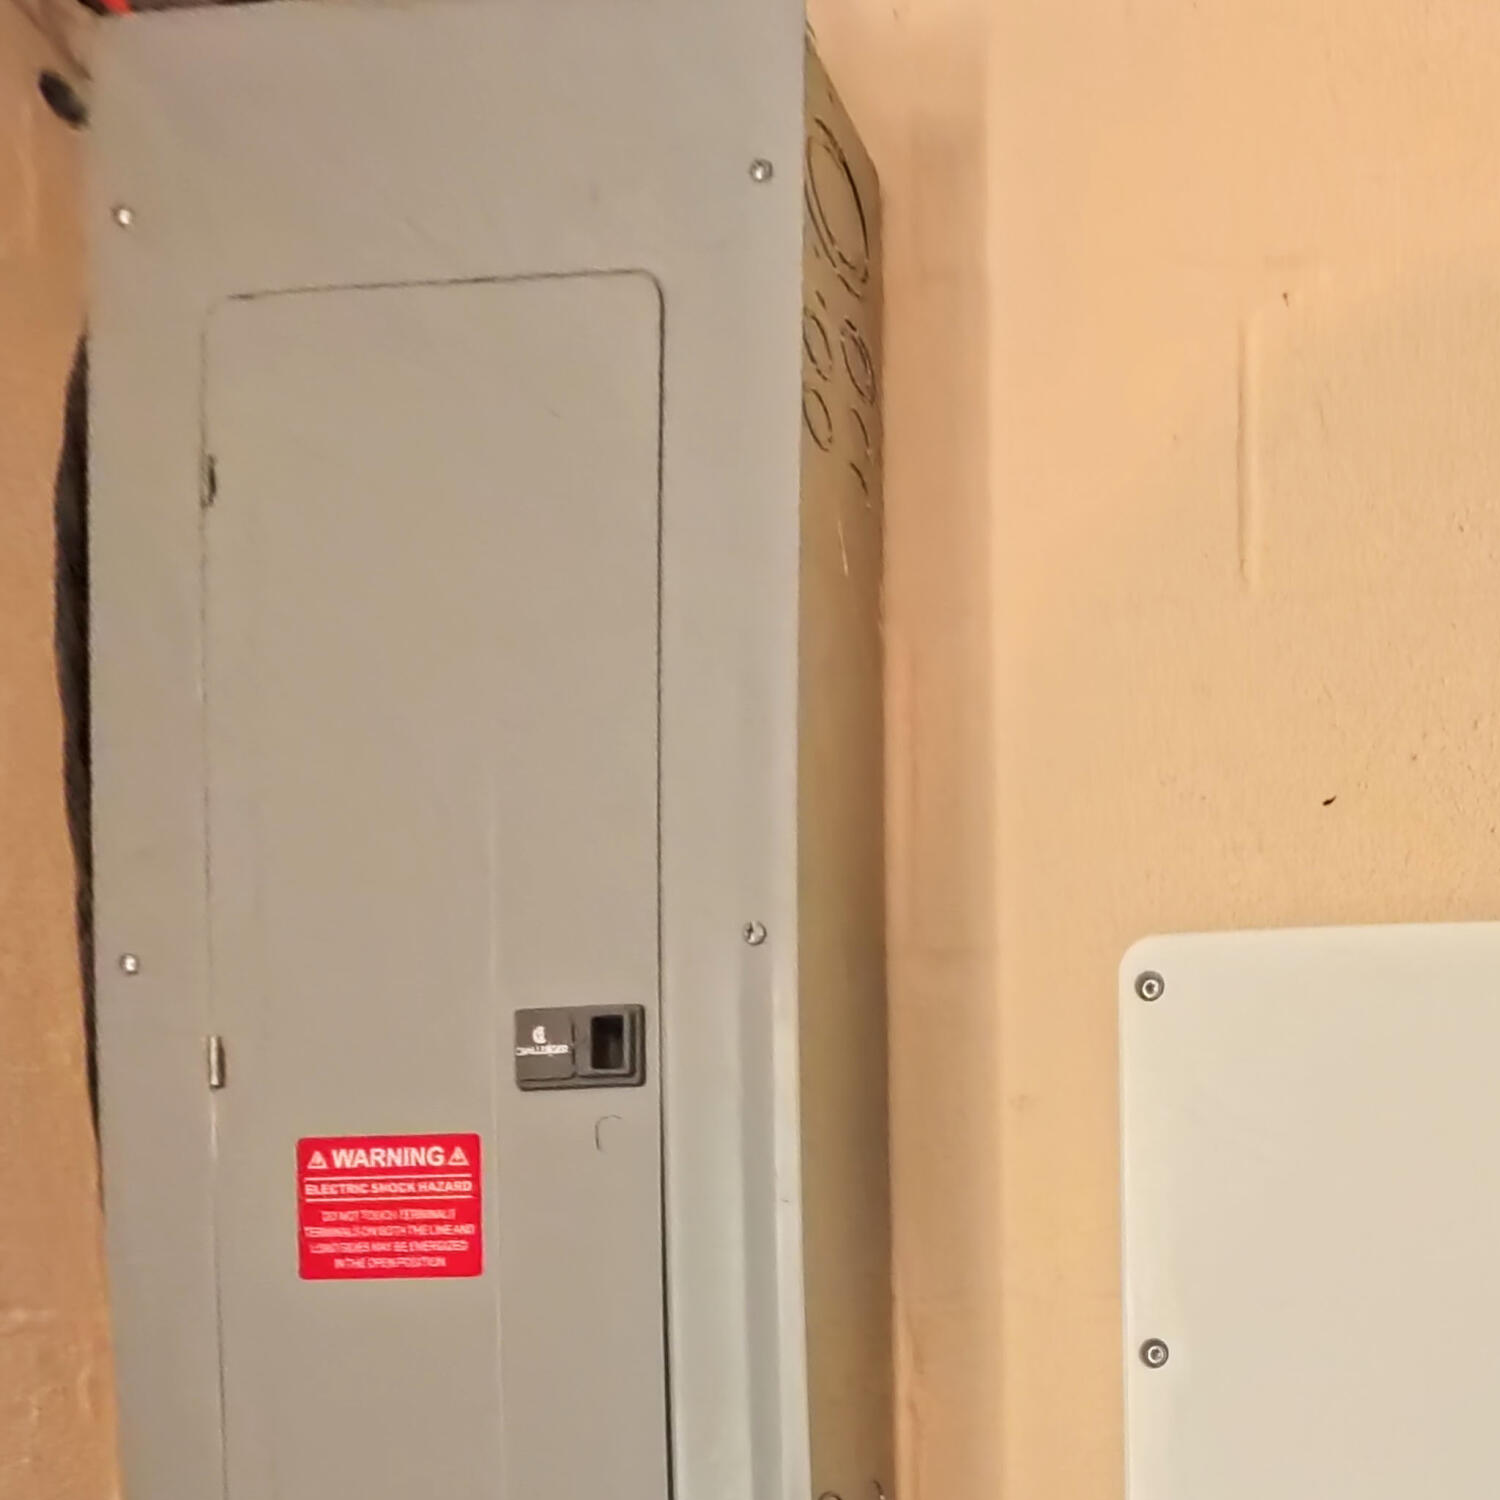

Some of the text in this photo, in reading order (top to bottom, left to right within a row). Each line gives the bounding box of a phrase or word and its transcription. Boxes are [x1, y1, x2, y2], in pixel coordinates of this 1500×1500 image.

[331, 1146, 446, 1168] WARNING
[304, 1180, 472, 1195] ELECTRIC SHOCK HAZARD
